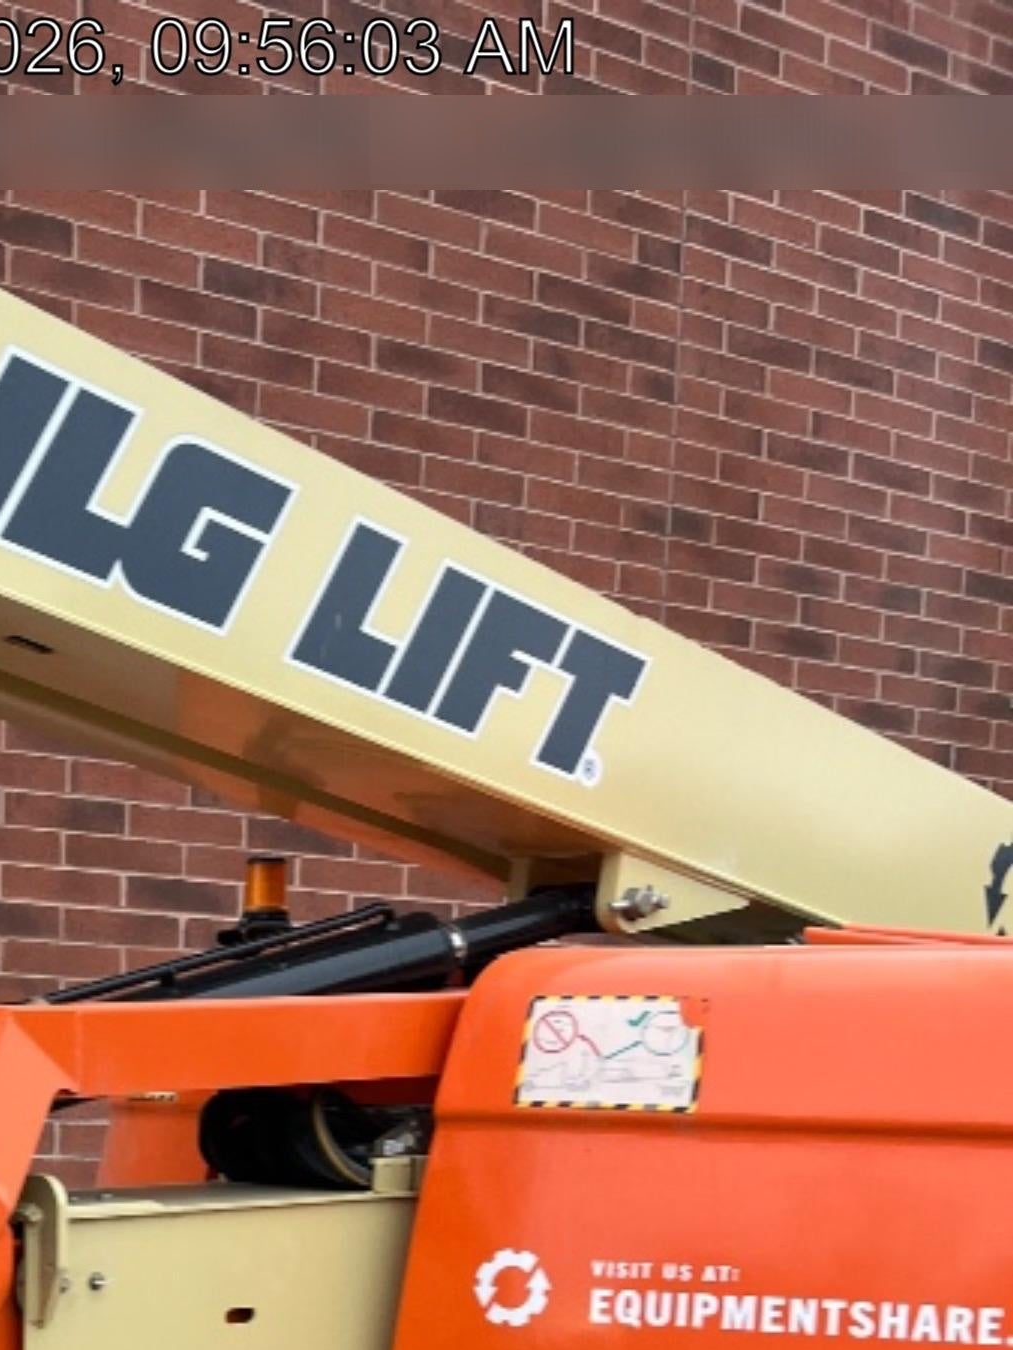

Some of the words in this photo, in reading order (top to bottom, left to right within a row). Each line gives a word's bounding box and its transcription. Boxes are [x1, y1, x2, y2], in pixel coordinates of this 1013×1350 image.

[284, 514, 652, 778] LIFT
[590, 1259, 654, 1280] VISIT
[661, 1262, 694, 1283] US
